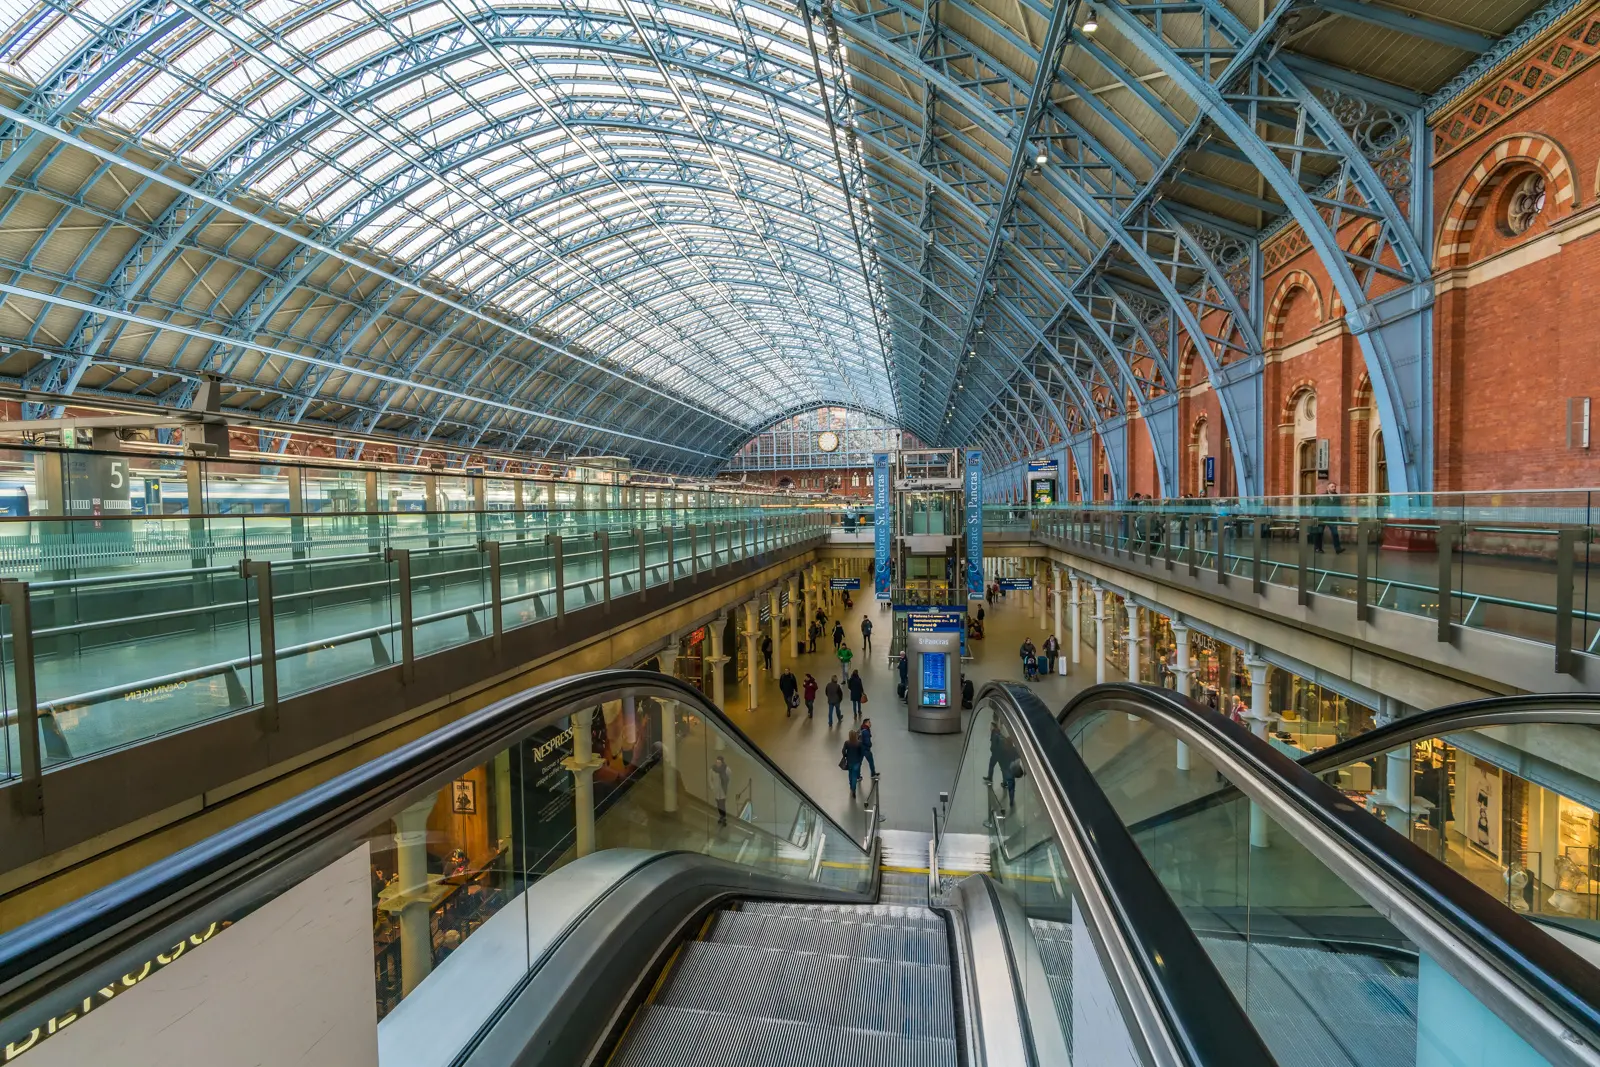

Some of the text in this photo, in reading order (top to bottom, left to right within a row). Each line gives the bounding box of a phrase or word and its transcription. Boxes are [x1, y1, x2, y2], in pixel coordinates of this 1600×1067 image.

[110, 462, 123, 489] 5
[876, 474, 885, 510] Pancras
[968, 471, 978, 508] Pancras
[876, 513, 885, 525] St.
[968, 511, 978, 524] St.
[876, 529, 886, 573] Celebrate
[968, 528, 979, 573] Celebrate
[1191, 632, 1217, 653] JOULES
[531, 726, 573, 763] NESPRESS
